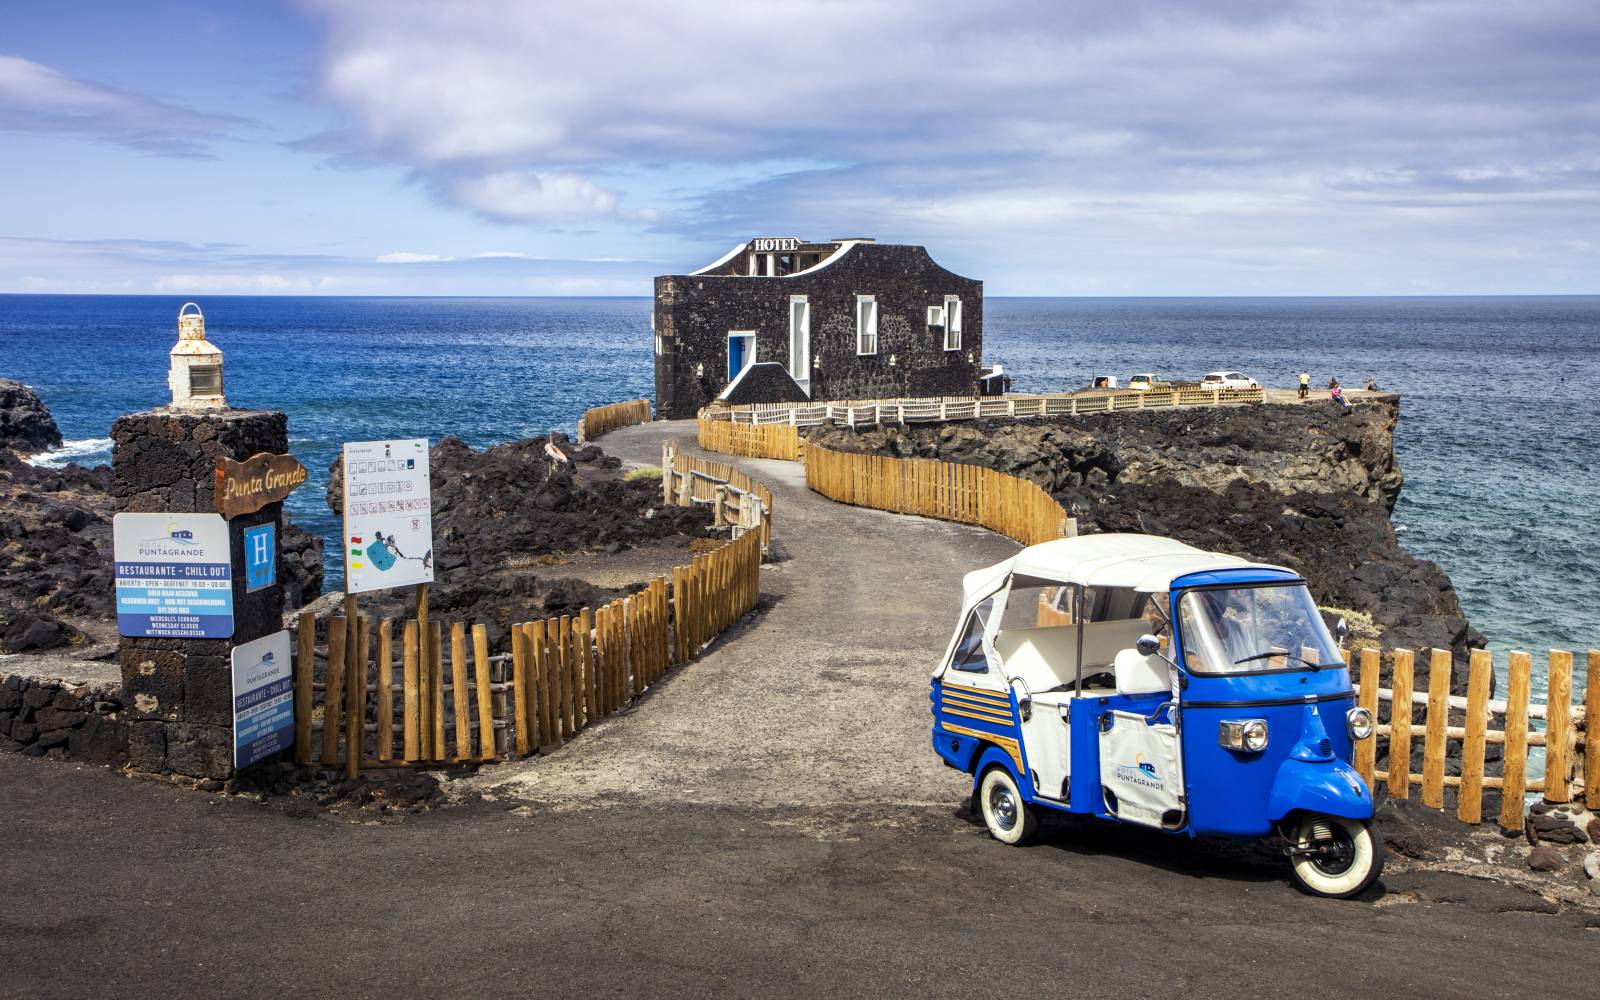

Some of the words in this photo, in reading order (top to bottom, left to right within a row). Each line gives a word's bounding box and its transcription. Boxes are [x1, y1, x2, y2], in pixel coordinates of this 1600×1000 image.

[755, 239, 798, 251] HOTEL
[222, 477, 263, 500] Punta
[265, 463, 306, 491] Grande
[139, 548, 205, 556] PUNTAGRANDE
[252, 532, 269, 566] H
[119, 565, 176, 576] RESTAURANTE
[185, 566, 208, 576] CHILL
[210, 567, 226, 577] OUT
[1117, 773, 1164, 791] PUNTAGRANDE
